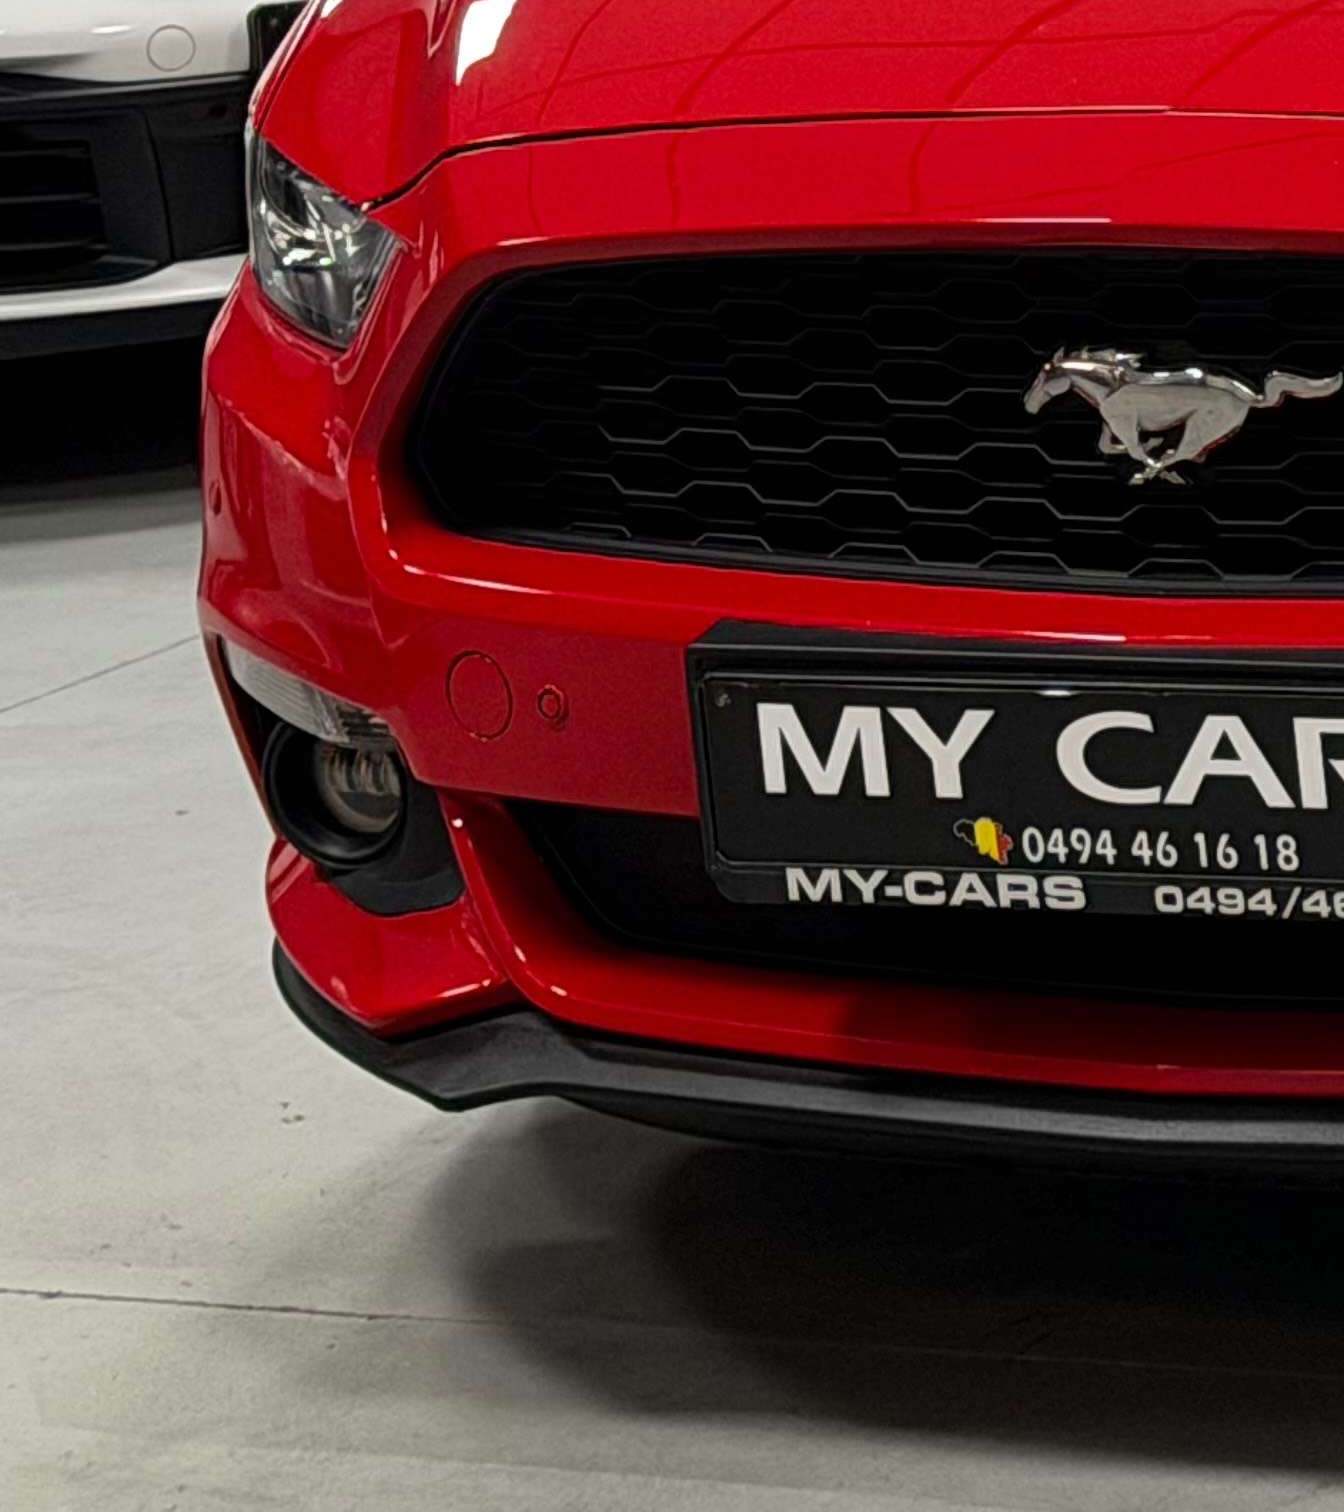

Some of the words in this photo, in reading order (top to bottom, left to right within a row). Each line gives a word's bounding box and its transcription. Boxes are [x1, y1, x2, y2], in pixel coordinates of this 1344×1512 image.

[756, 702, 995, 799] MY
[1021, 826, 1118, 866] 0494
[1131, 830, 1179, 868] 46
[1193, 831, 1239, 870] 16
[1253, 833, 1300, 872] 18
[785, 867, 1087, 910] MY-CARS
